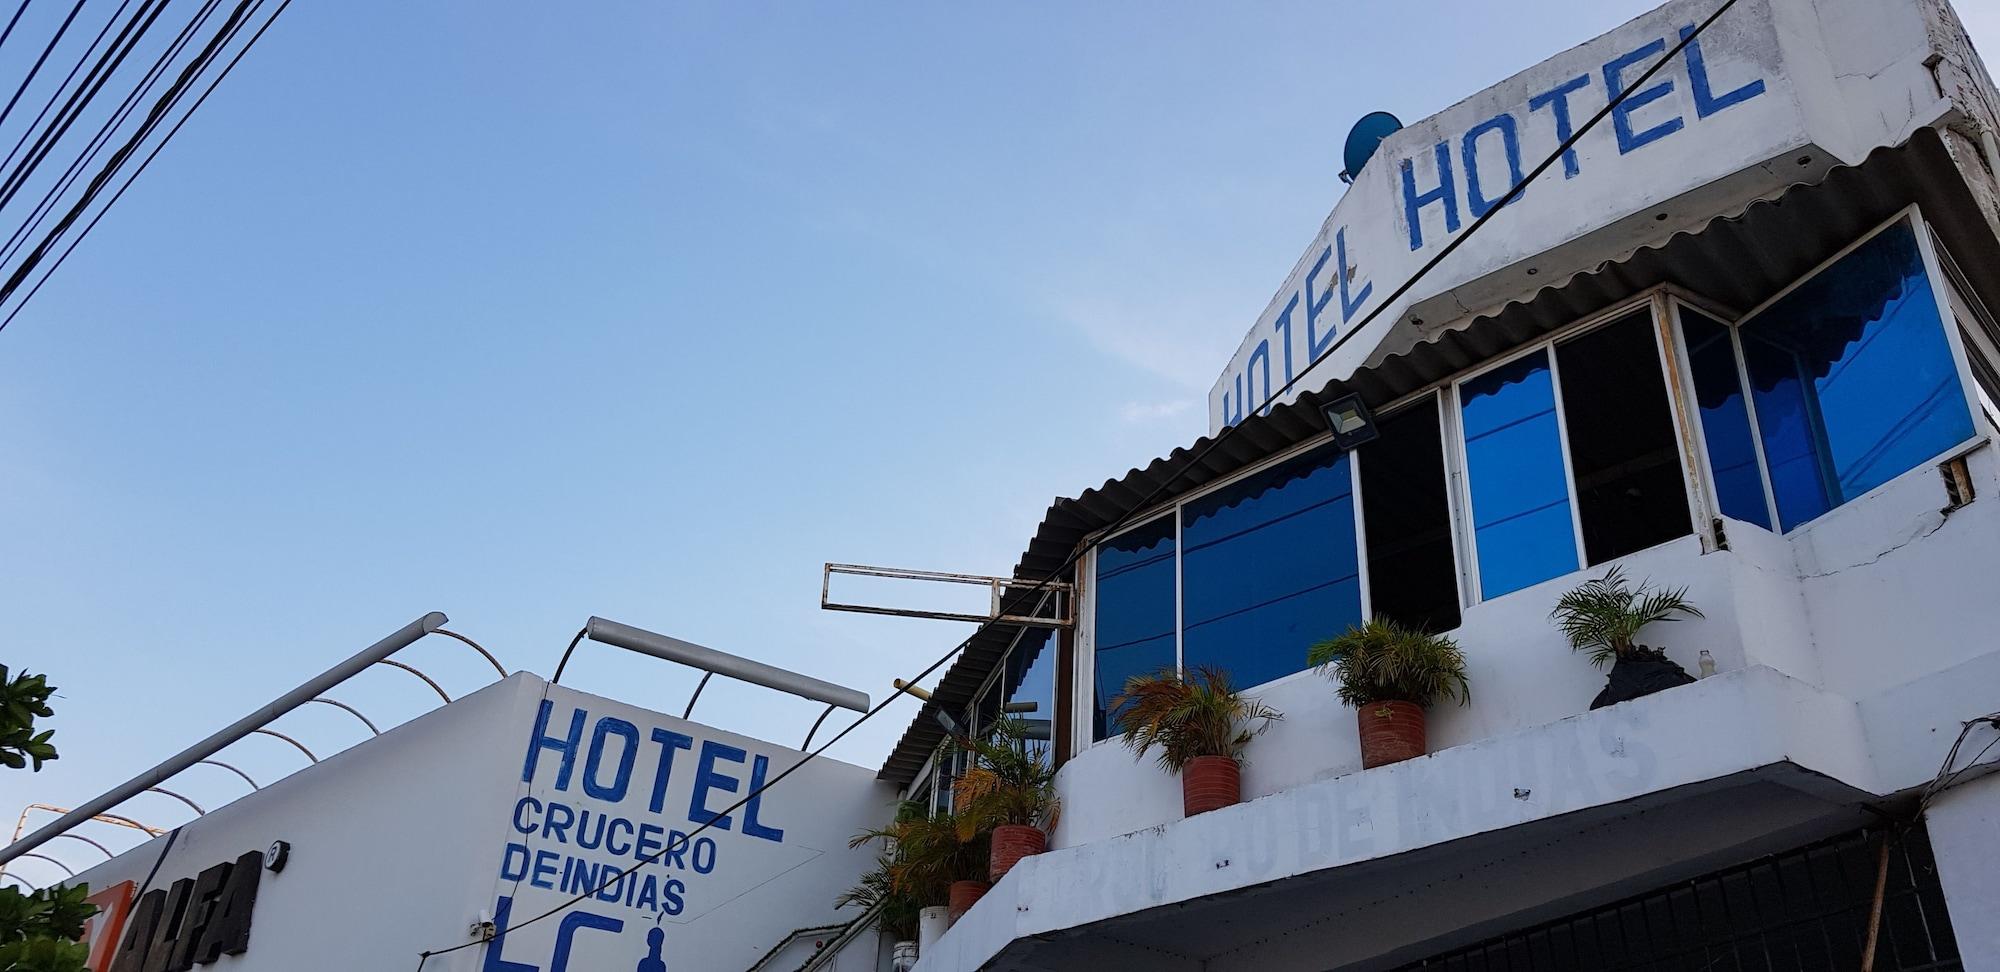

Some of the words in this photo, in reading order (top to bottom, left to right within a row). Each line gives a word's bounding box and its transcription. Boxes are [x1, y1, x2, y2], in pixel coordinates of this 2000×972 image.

[1398, 23, 1767, 251] HOTEL
[1222, 225, 1373, 427] HOTEL
[512, 796, 718, 876] CRUCERO
[522, 699, 785, 844] HOTEL
